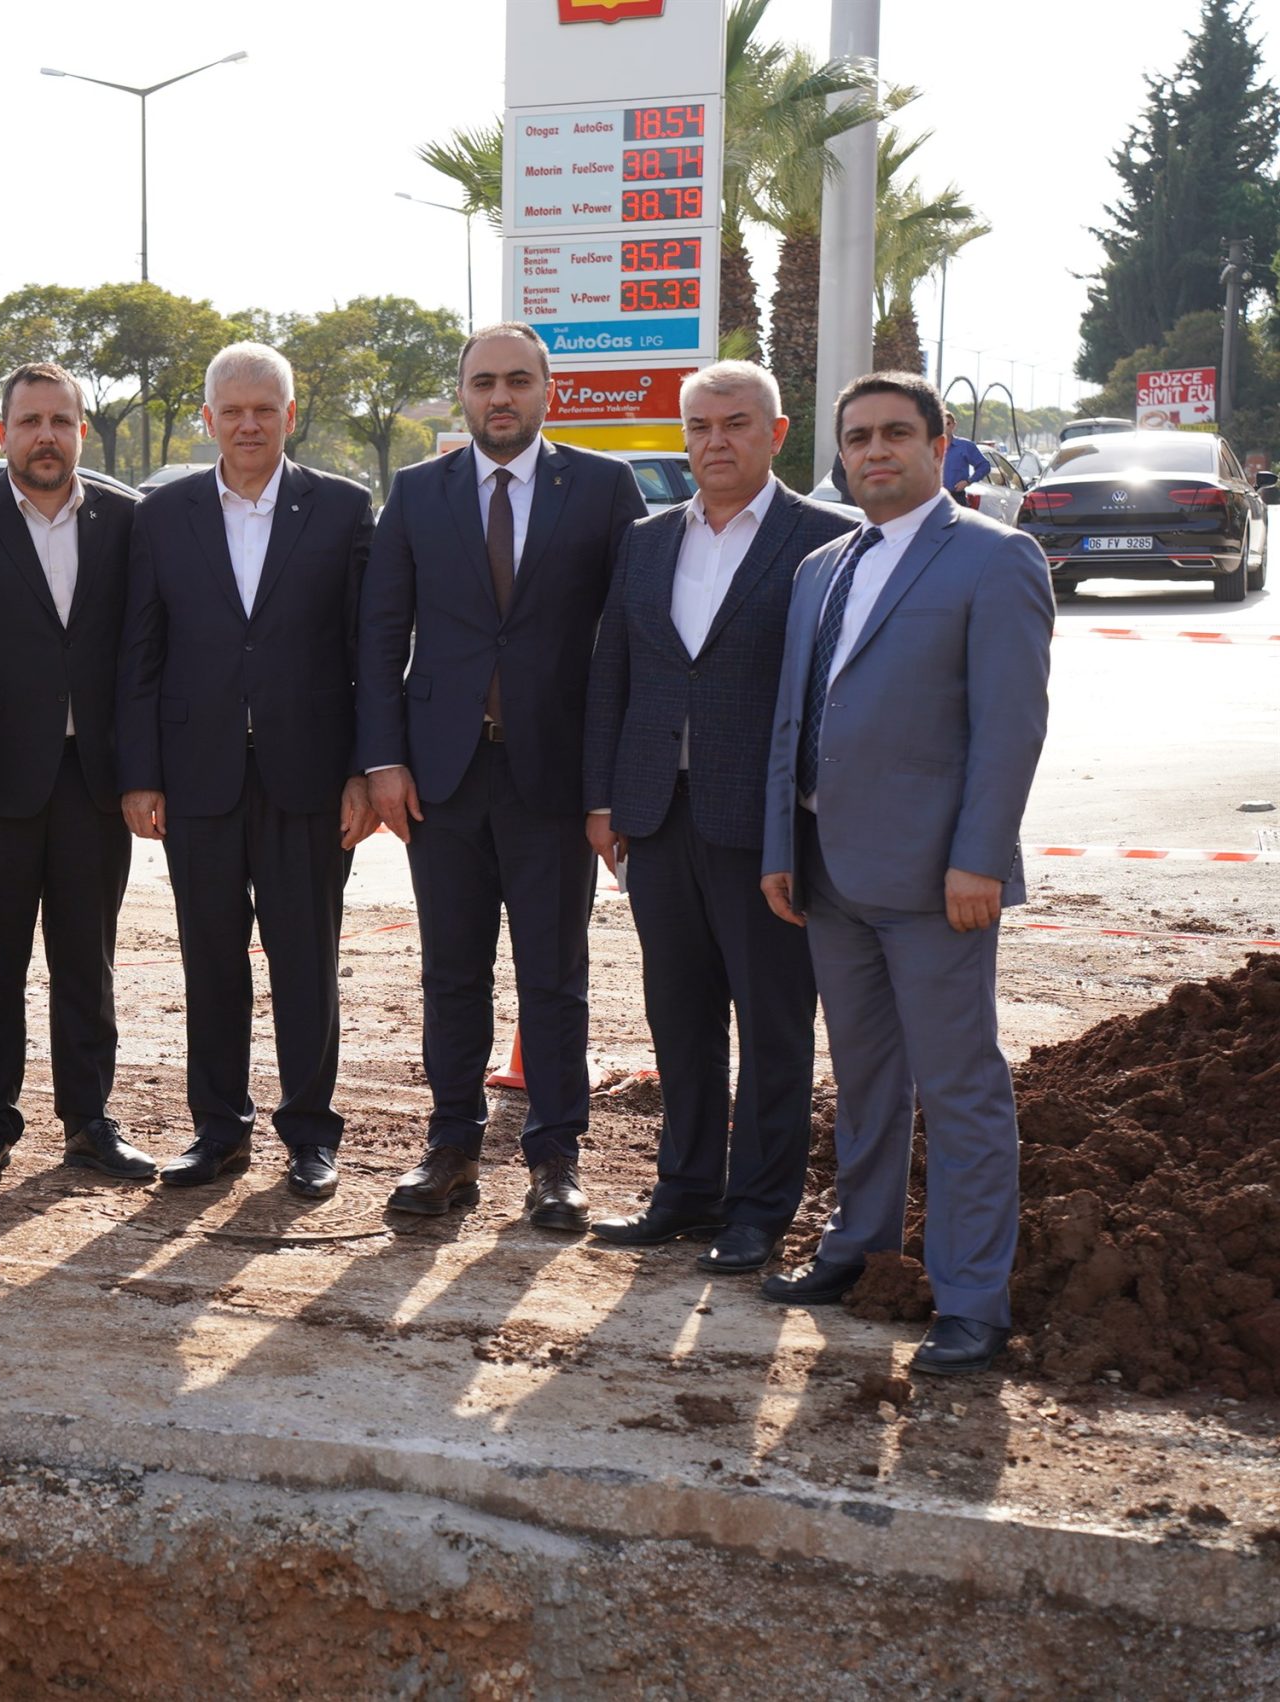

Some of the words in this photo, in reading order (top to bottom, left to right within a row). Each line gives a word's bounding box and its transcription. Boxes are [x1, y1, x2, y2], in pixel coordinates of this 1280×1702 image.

[525, 125, 559, 138] Otogaz
[573, 121, 613, 134] AutoGas
[634, 106, 704, 139] 18.54
[525, 165, 562, 177] Motorin
[572, 162, 614, 175] FuelSave
[623, 146, 703, 180] 38.74
[524, 205, 562, 217] Motorin
[572, 203, 612, 214] V-Power
[622, 187, 702, 221] 38.79
[523, 256, 548, 265] Benzin
[571, 253, 613, 264] FuelSave
[621, 240, 701, 272] 35.27
[523, 267, 533, 275] 95
[535, 267, 558, 275] Oktan
[523, 296, 548, 305] Benzin
[571, 293, 611, 304] V-Power
[620, 279, 700, 312] 35.33
[523, 307, 533, 315] 95
[535, 306, 558, 315] Oktan
[553, 333, 633, 350] AutoGas
[640, 335, 664, 347] LPG
[1149, 371, 1203, 388] DÜZCE
[557, 387, 647, 403] V-Power
[558, 406, 604, 414] Performans
[1089, 538, 1101, 549] 06
[1108, 538, 1120, 549] FV
[1127, 537, 1151, 549] 9285
